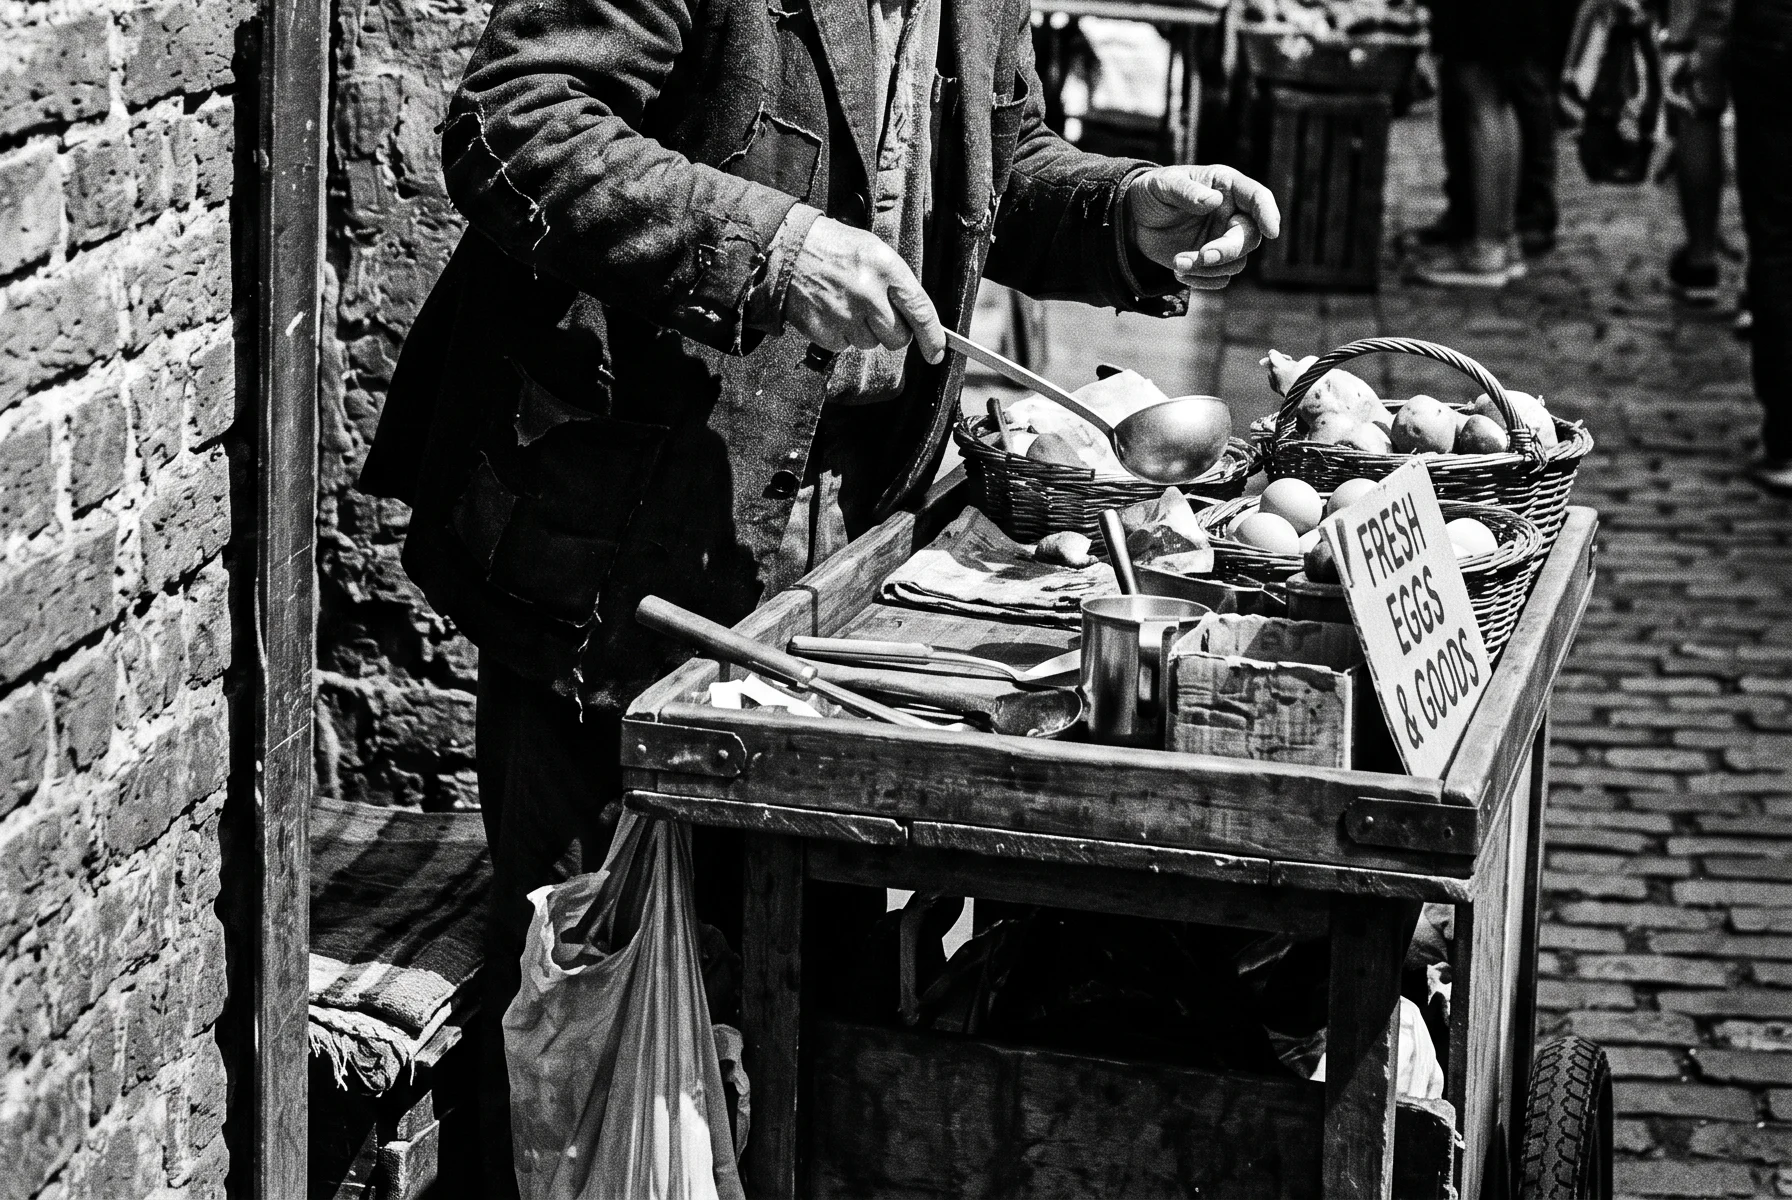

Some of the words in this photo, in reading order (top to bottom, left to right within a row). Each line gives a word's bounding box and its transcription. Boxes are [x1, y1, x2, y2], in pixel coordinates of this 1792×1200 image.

[1356, 492, 1426, 587] FRESH
[1386, 565, 1445, 656] EGGS
[1397, 684, 1424, 749] &
[1415, 628, 1479, 730] GOODS
